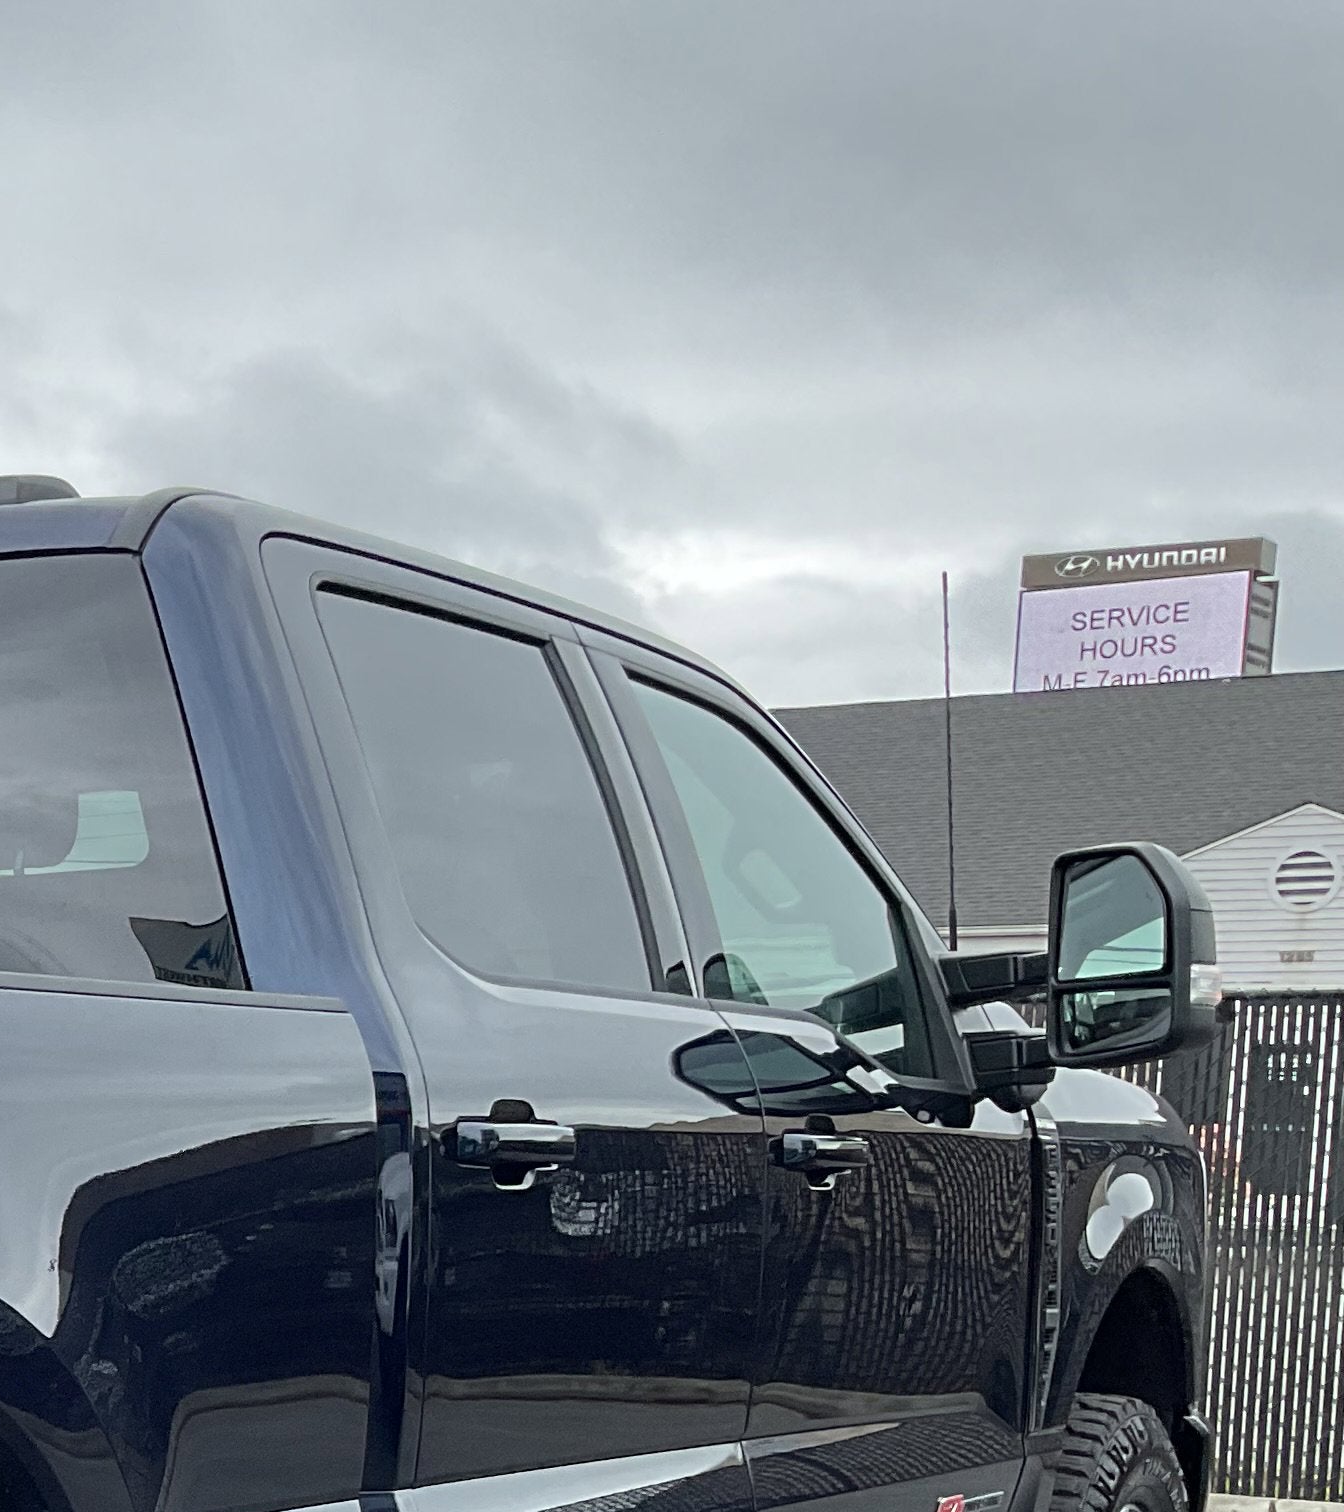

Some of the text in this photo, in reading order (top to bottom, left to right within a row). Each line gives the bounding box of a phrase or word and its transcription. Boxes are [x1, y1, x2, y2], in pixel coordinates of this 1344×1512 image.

[1106, 546, 1227, 572] HYUNDAI
[1071, 601, 1191, 632] SERVICE
[1079, 634, 1178, 661] HOURS
